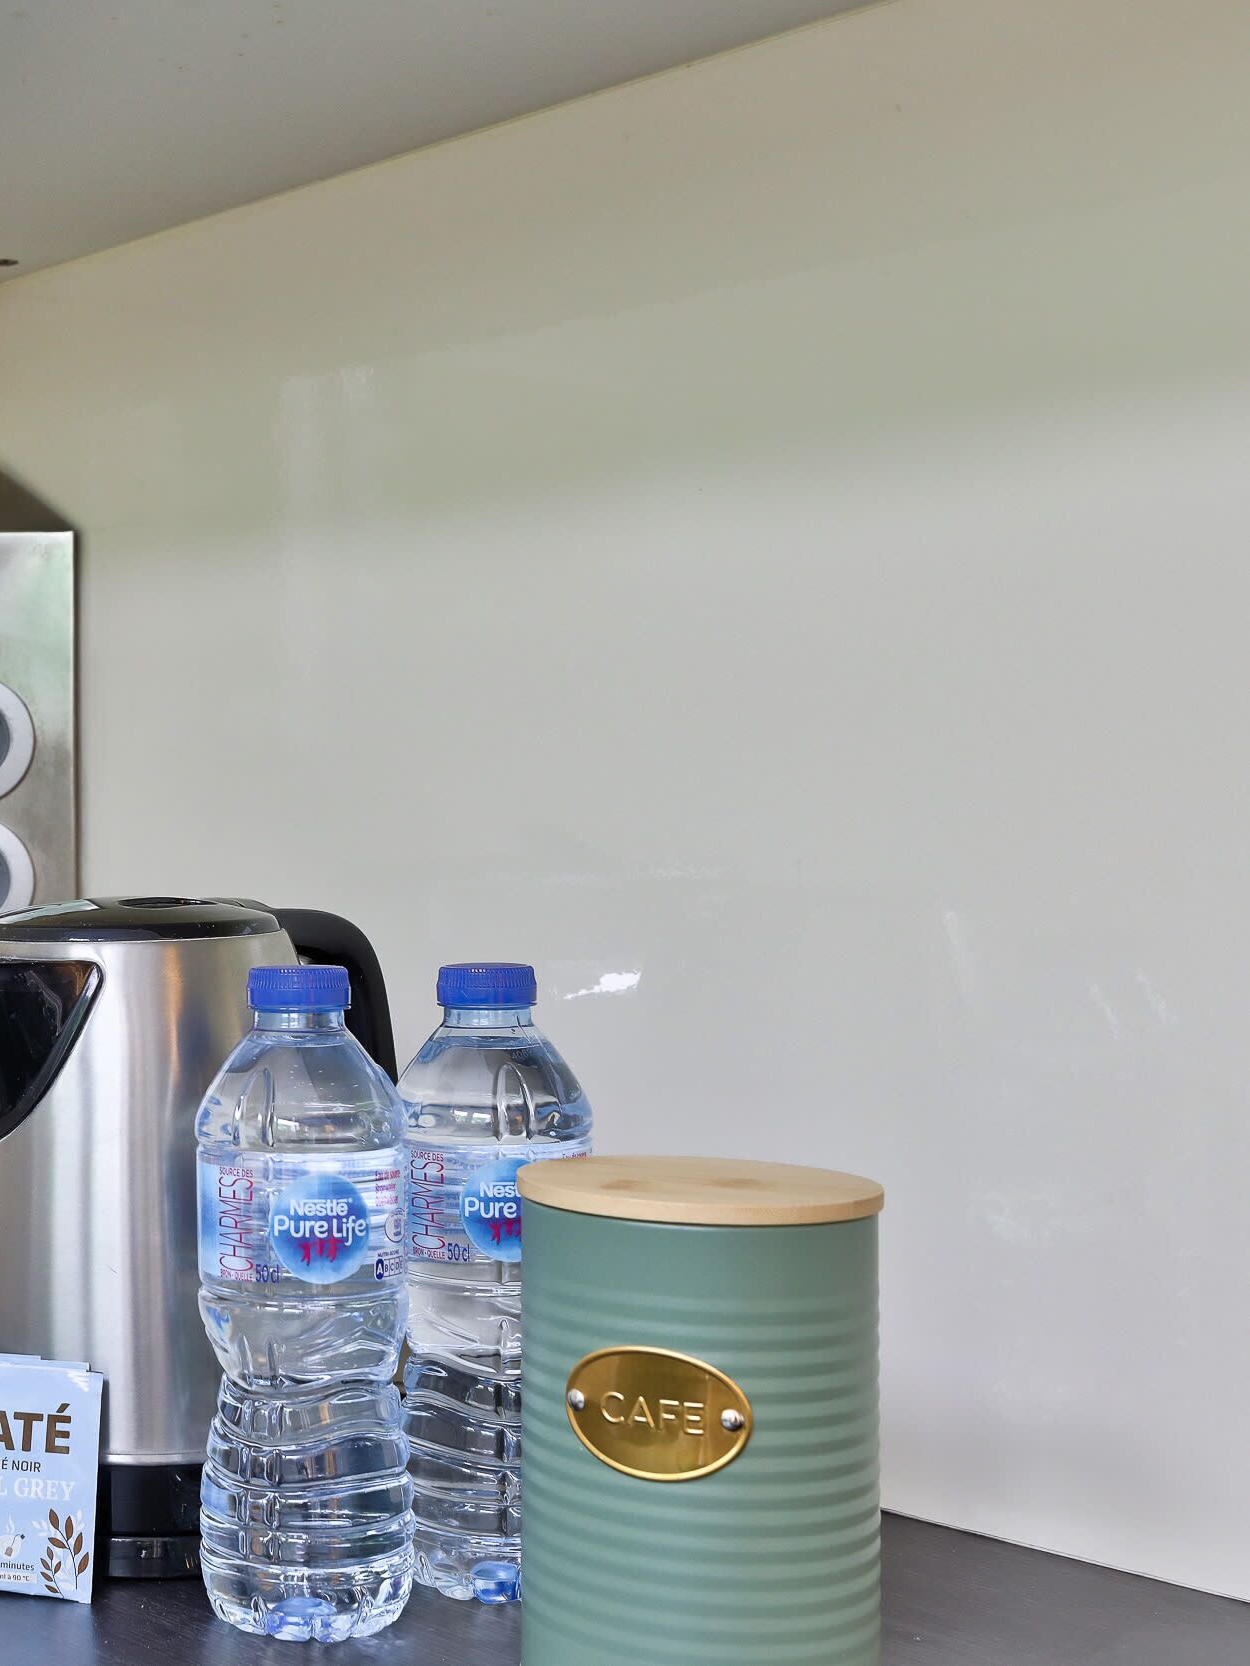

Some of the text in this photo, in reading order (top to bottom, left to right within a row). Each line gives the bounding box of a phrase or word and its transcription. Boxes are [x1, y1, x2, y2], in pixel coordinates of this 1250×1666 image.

[411, 1150, 444, 1162] SOURCE DES
[219, 1166, 254, 1178] SOURCE DES
[289, 1198, 349, 1216] Nestlé
[410, 1159, 446, 1250] CHARMES
[464, 1197, 517, 1219] Pure
[218, 1176, 254, 1271] CHARMES
[273, 1214, 367, 1246] Pure Life
[427, 1249, 445, 1260] QUELLE
[600, 1391, 706, 1436] CAFE
[11, 1460, 42, 1473] NOIR
[13, 1476, 76, 1502] GREY
[0, 1560, 35, 1571] minutes
